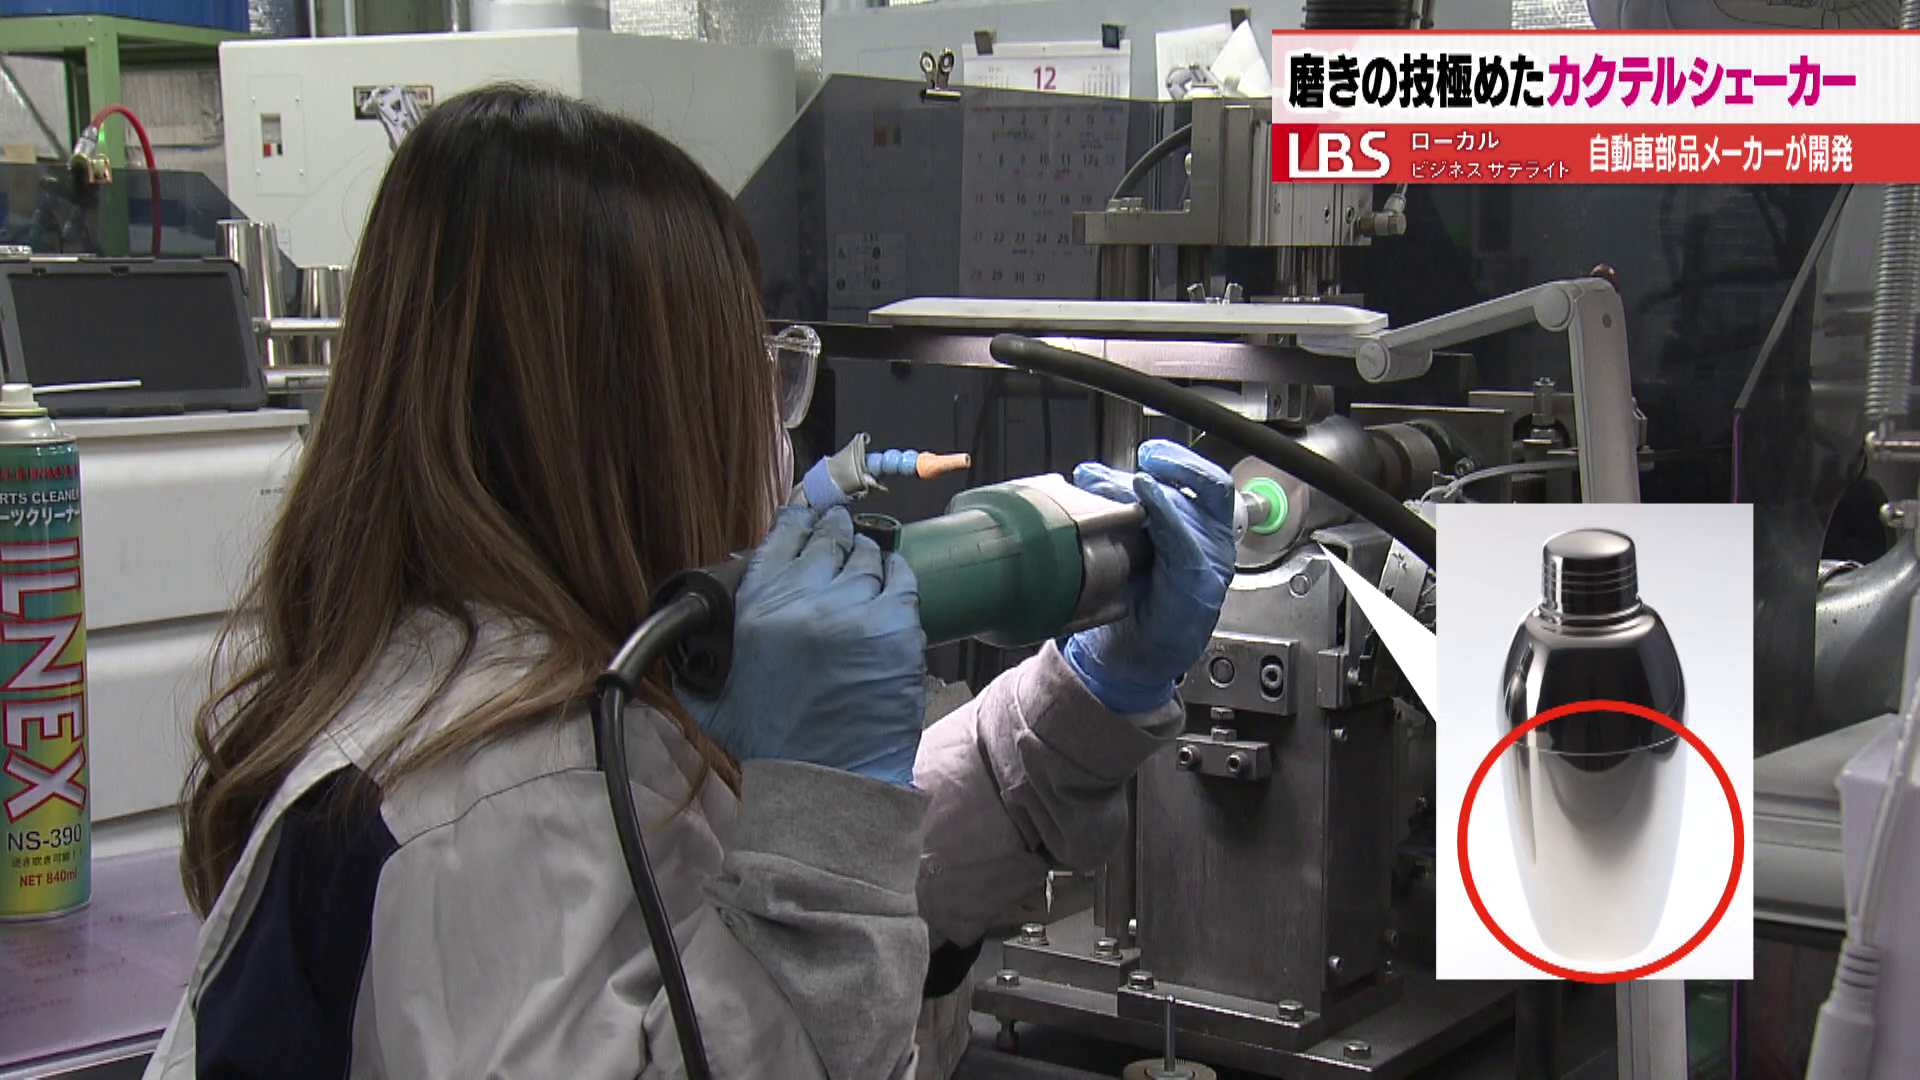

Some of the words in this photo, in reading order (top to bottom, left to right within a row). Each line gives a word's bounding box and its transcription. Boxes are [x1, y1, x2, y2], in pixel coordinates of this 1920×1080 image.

[1033, 67, 1056, 90] 12
[1040, 153, 1050, 165] 10
[1061, 153, 1071, 165] 11
[995, 192, 1005, 204] 15
[1017, 192, 1027, 205] 16
[1038, 192, 1047, 204] 17
[1060, 193, 1070, 205] 18
[993, 232, 1004, 243] 22
[1036, 232, 1047, 244] 24
[1057, 232, 1069, 244] 25
[992, 270, 1003, 281] 29
[8, 824, 82, 852] NS-390
[20, 872, 42, 888] NET
